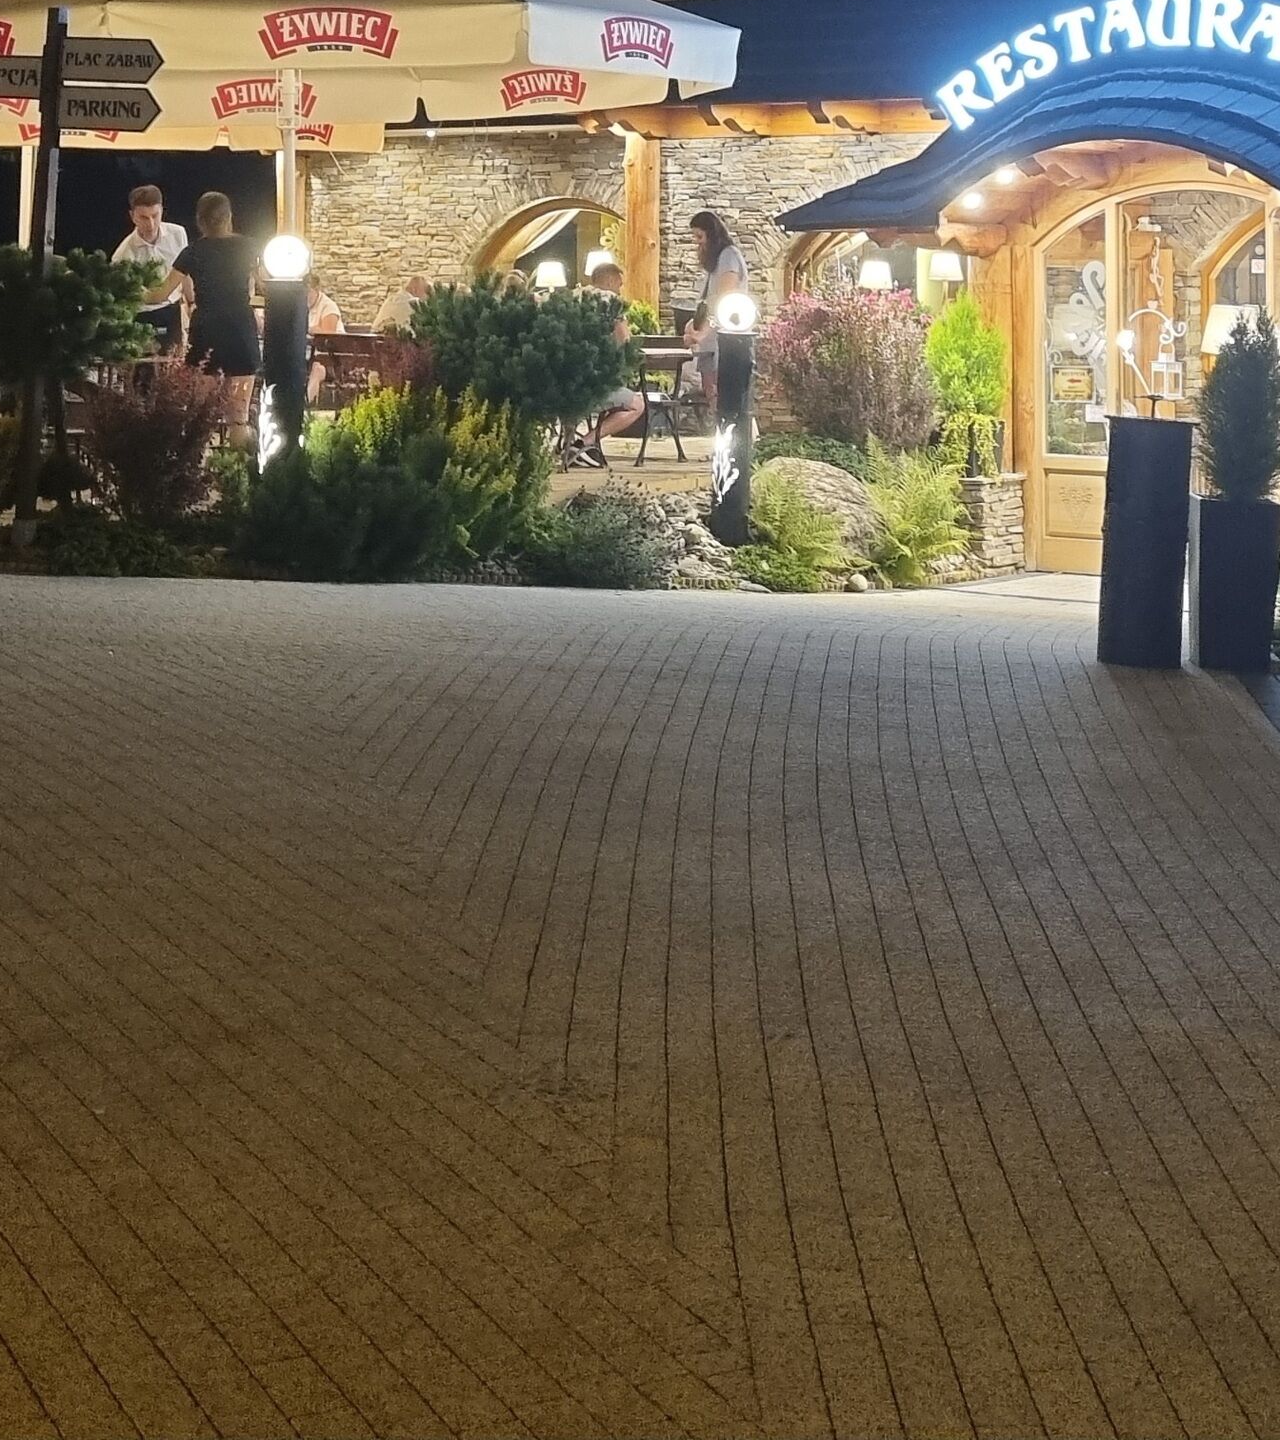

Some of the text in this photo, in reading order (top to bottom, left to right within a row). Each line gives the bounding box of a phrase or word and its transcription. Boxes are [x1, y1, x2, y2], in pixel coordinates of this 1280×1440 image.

[276, 12, 382, 43] ŻYWIEC
[611, 20, 667, 53] ŻYWIEC
[65, 52, 155, 69] PLAC ZABAW
[66, 99, 141, 118] PARKING
